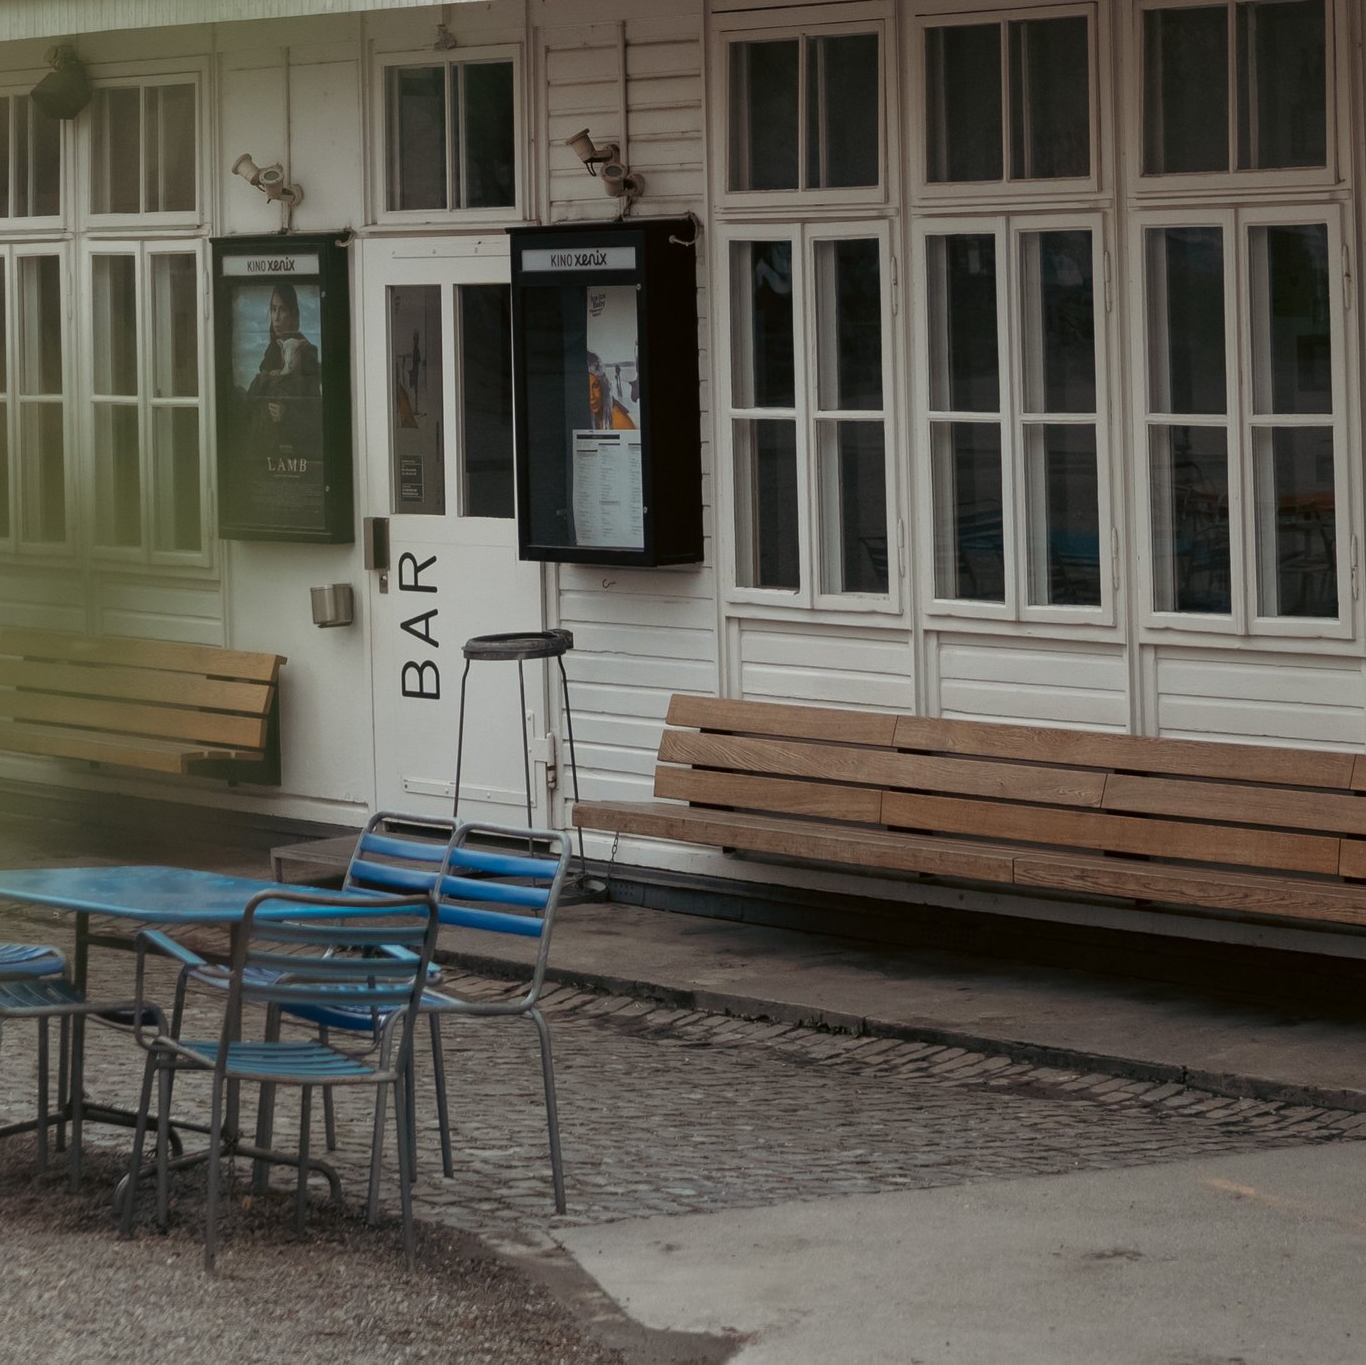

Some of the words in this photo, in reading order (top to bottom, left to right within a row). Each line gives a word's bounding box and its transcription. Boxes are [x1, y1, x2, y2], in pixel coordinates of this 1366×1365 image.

[246, 259, 267, 273] KINO
[267, 255, 296, 274] xenix
[550, 253, 573, 267] KINO
[574, 249, 608, 267] xenix
[267, 457, 308, 473] LAMB
[398, 551, 441, 700] BAR
